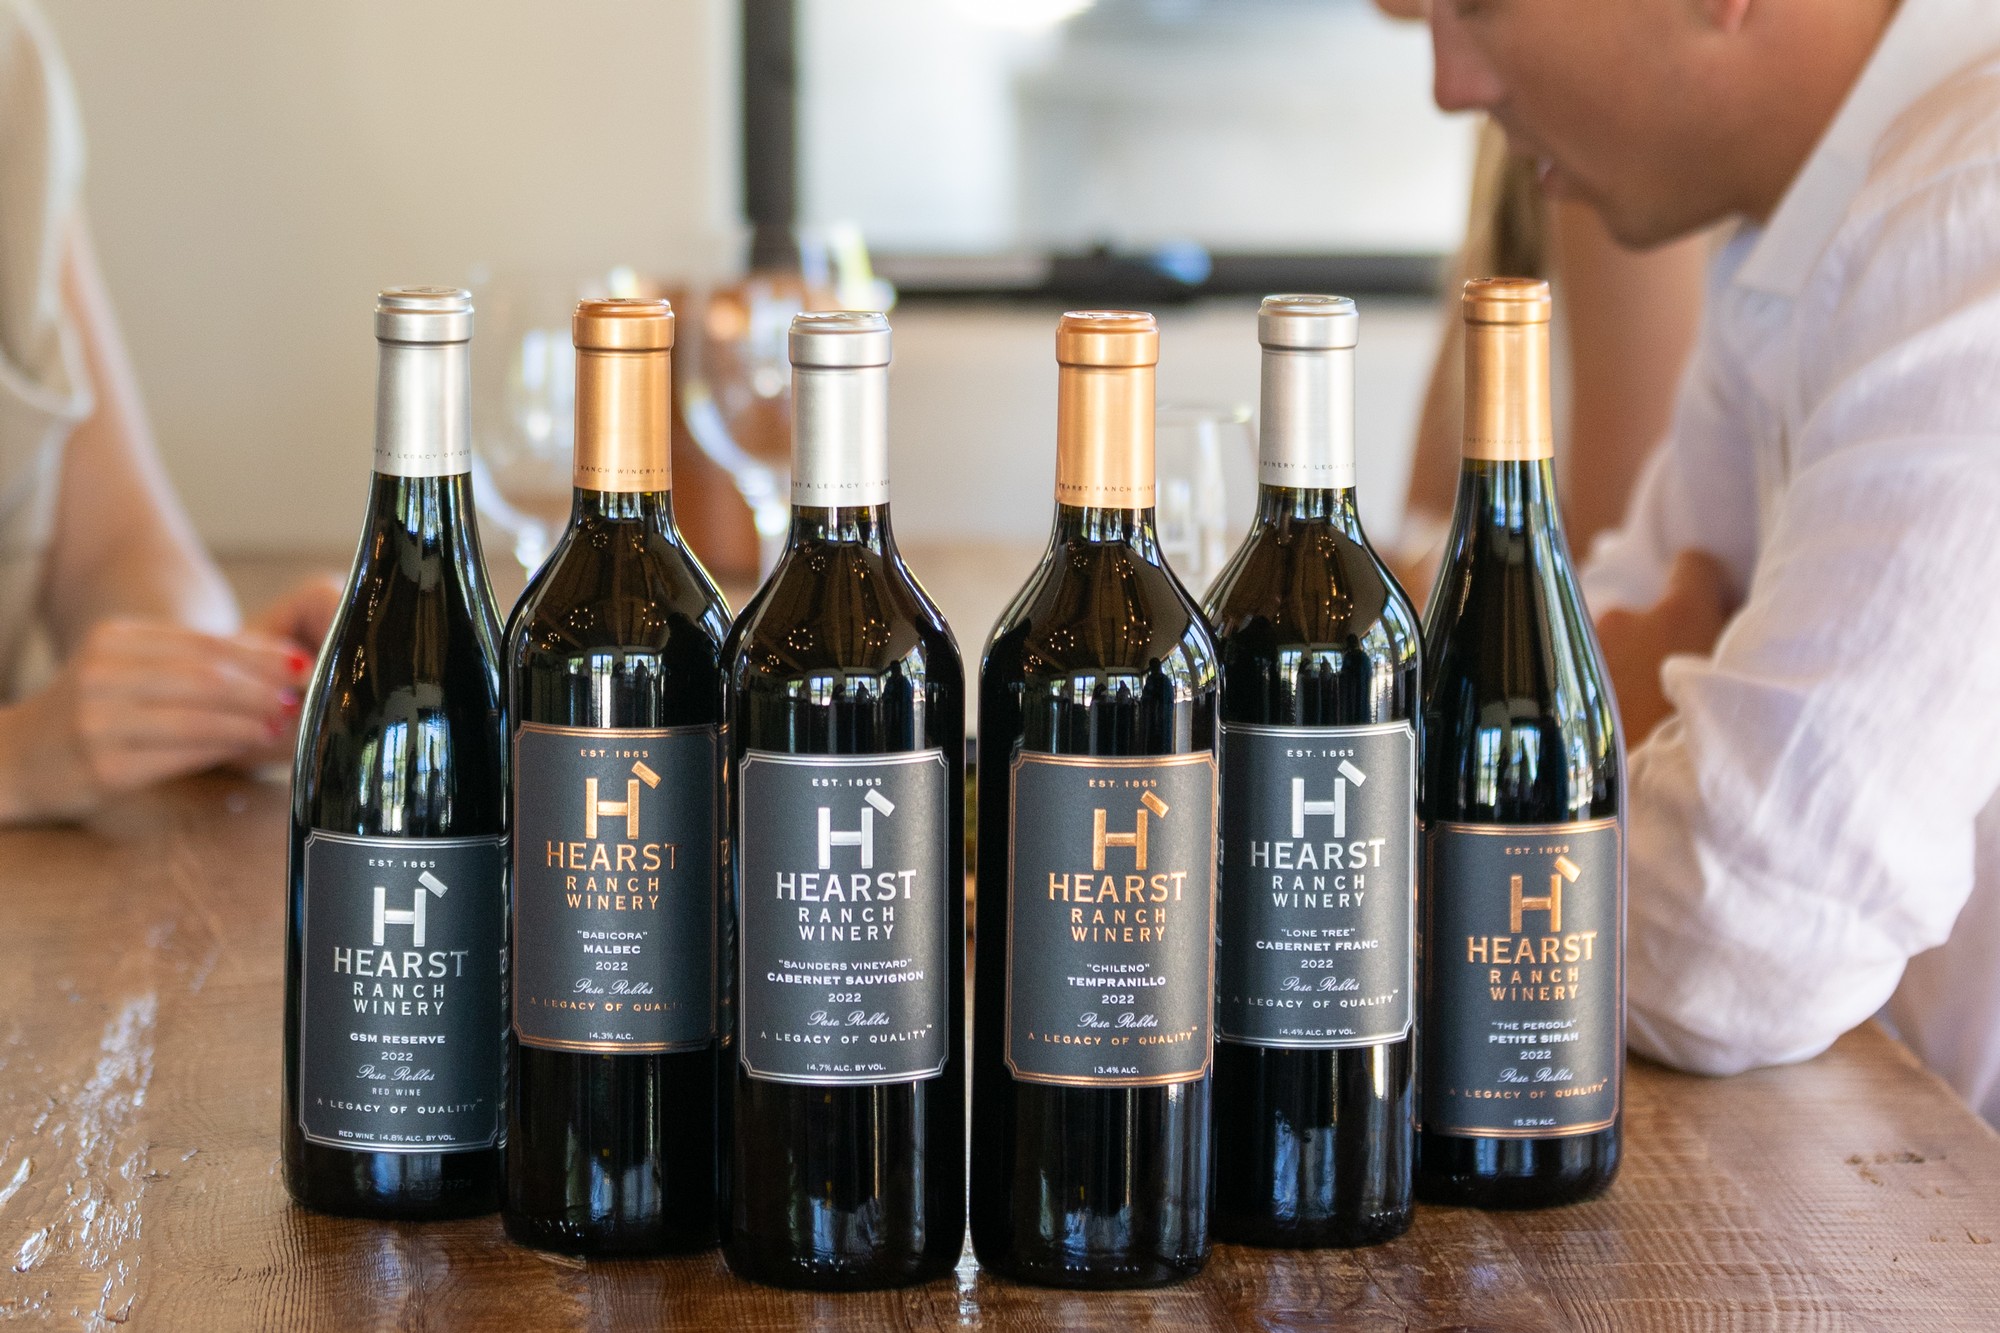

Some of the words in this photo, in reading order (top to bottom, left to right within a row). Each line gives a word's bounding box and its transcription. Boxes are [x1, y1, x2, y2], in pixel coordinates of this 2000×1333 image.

[581, 749, 609, 758] EST.
[616, 750, 648, 758] 1865
[1287, 750, 1316, 758] EST.
[1322, 749, 1354, 758] 1865
[812, 778, 842, 787] EST.
[848, 778, 882, 786] 1865
[1089, 779, 1119, 788] EST.
[1125, 779, 1157, 788] 1865
[546, 840, 680, 871] HEARST
[1251, 838, 1386, 870] HEARST
[1505, 847, 1535, 855] EST.
[1539, 845, 1570, 854] 1865
[369, 859, 397, 868] EST.
[403, 860, 436, 869] 1865
[566, 876, 659, 892] RANCH
[776, 869, 916, 902] HEARST
[1048, 871, 1187, 903] HEARST
[1273, 875, 1365, 891] RANCH
[567, 894, 659, 910] WINERY
[1273, 892, 1365, 909] WINERY
[799, 907, 894, 923] RANCH
[1071, 908, 1166, 924] RANCH
[799, 924, 894, 941] WINERY
[1071, 926, 1166, 942] WINERY
[584, 945, 640, 954] MALBEC
[1256, 941, 1329, 951] CABERNET
[1335, 939, 1379, 950] FRANC
[1467, 931, 1598, 965] HEARST
[333, 946, 468, 978] HEARST
[596, 961, 628, 971] 2022
[1301, 959, 1333, 969] 2022
[767, 972, 841, 985] CABERNET
[845, 971, 924, 985] SAUVIGNON
[1068, 976, 1166, 987] TEMPRANILLO
[1489, 967, 1579, 984] RANCH
[354, 981, 445, 998] RANCH
[573, 979, 604, 995] Paso
[609, 979, 654, 995] Robles
[1280, 975, 1312, 992] Paso
[1316, 976, 1360, 992] Robles
[828, 993, 861, 1002] 2022
[1102, 995, 1135, 1004] 2022
[1490, 985, 1578, 1001] WINERY
[354, 999, 445, 1015] WINERY
[605, 1002, 623, 1012] OF
[1248, 997, 1303, 1009] LEGACY
[1312, 1000, 1330, 1009] OF
[807, 1011, 840, 1026] Paso
[845, 1011, 890, 1027] Robles
[1077, 1012, 1110, 1029] Paso
[1114, 1013, 1159, 1029] Robles
[589, 1032, 613, 1040] 14.3%
[615, 1032, 634, 1040] ALC.
[760, 1031, 767, 1039] A
[776, 1032, 831, 1044] LEGACY
[841, 1035, 859, 1044] OF
[1279, 1027, 1303, 1036] 14.4%
[1305, 1028, 1324, 1036] ALC.
[1326, 1028, 1338, 1036] BY
[1338, 1027, 1356, 1035] VOL.
[1488, 1034, 1537, 1044] PETITE
[1541, 1032, 1578, 1043] SIRAH
[350, 1032, 378, 1043] GSM
[382, 1035, 446, 1045] RESERVE
[1028, 1032, 1035, 1040] A
[1043, 1034, 1101, 1045] LEGACY
[1111, 1036, 1129, 1045] OF
[381, 1052, 414, 1062] 2022
[1520, 1051, 1551, 1060] 2022
[356, 1064, 390, 1081] Paso
[393, 1066, 436, 1081] Robles
[807, 1063, 832, 1072] 14.7%
[833, 1063, 852, 1071] ALC.
[855, 1063, 866, 1071] BY
[866, 1062, 886, 1070] VOL.
[1094, 1066, 1119, 1074] 13.4%
[1120, 1066, 1139, 1074] ALC.
[372, 1087, 390, 1096] RED
[396, 1088, 421, 1097] WINE
[1465, 1089, 1521, 1100] LEGACY
[1530, 1090, 1547, 1099] OF
[330, 1100, 381, 1113] LEGACY
[390, 1105, 407, 1114] OF
[338, 1130, 354, 1139] RED
[355, 1131, 374, 1140] WINE
[379, 1133, 404, 1142] 14.8%
[405, 1134, 424, 1142] ALC.
[426, 1134, 437, 1142] BY
[438, 1133, 456, 1141] VOL.
